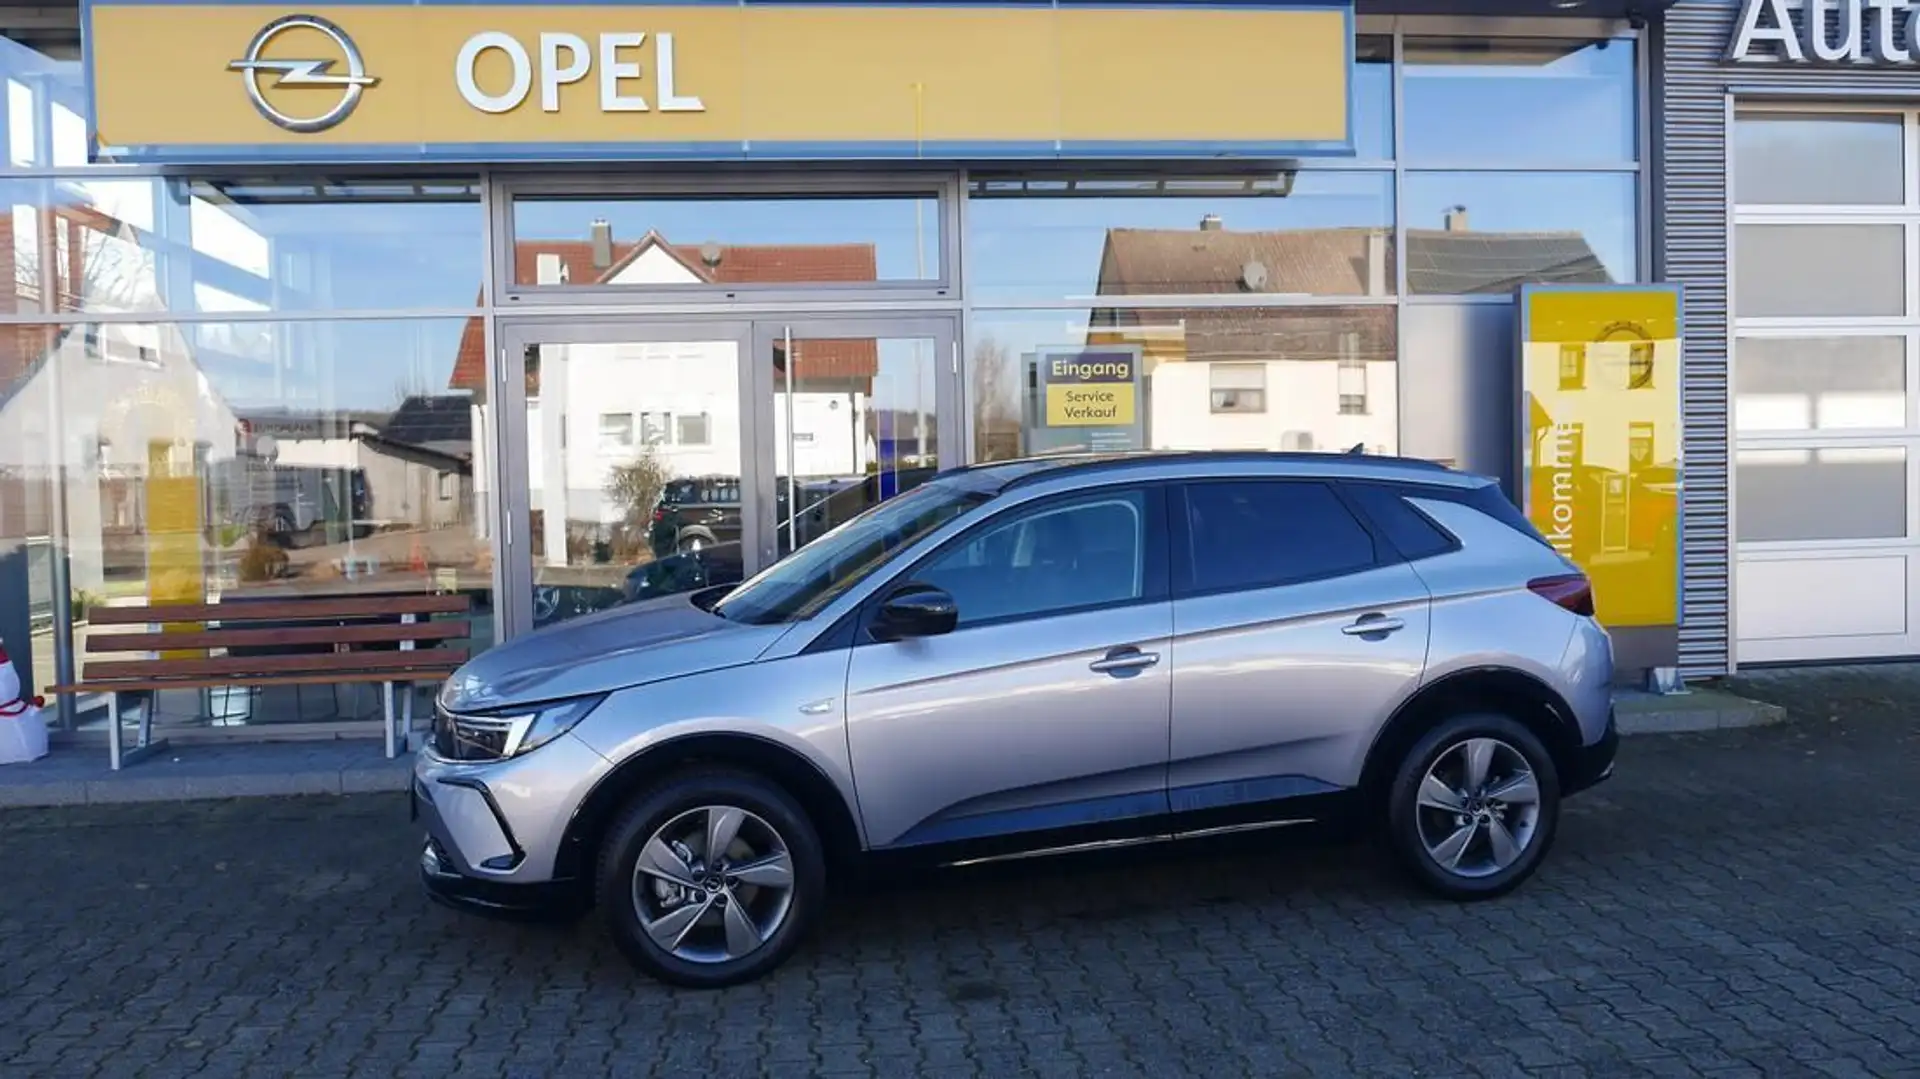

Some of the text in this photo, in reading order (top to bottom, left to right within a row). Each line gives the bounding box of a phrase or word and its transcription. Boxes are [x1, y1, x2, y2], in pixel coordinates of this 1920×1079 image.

[1731, 0, 1920, 61] Aut
[455, 31, 705, 113] OPEL
[1052, 358, 1129, 379] Eingang
[1066, 390, 1114, 402] Service
[1064, 404, 1117, 418] Verkauf
